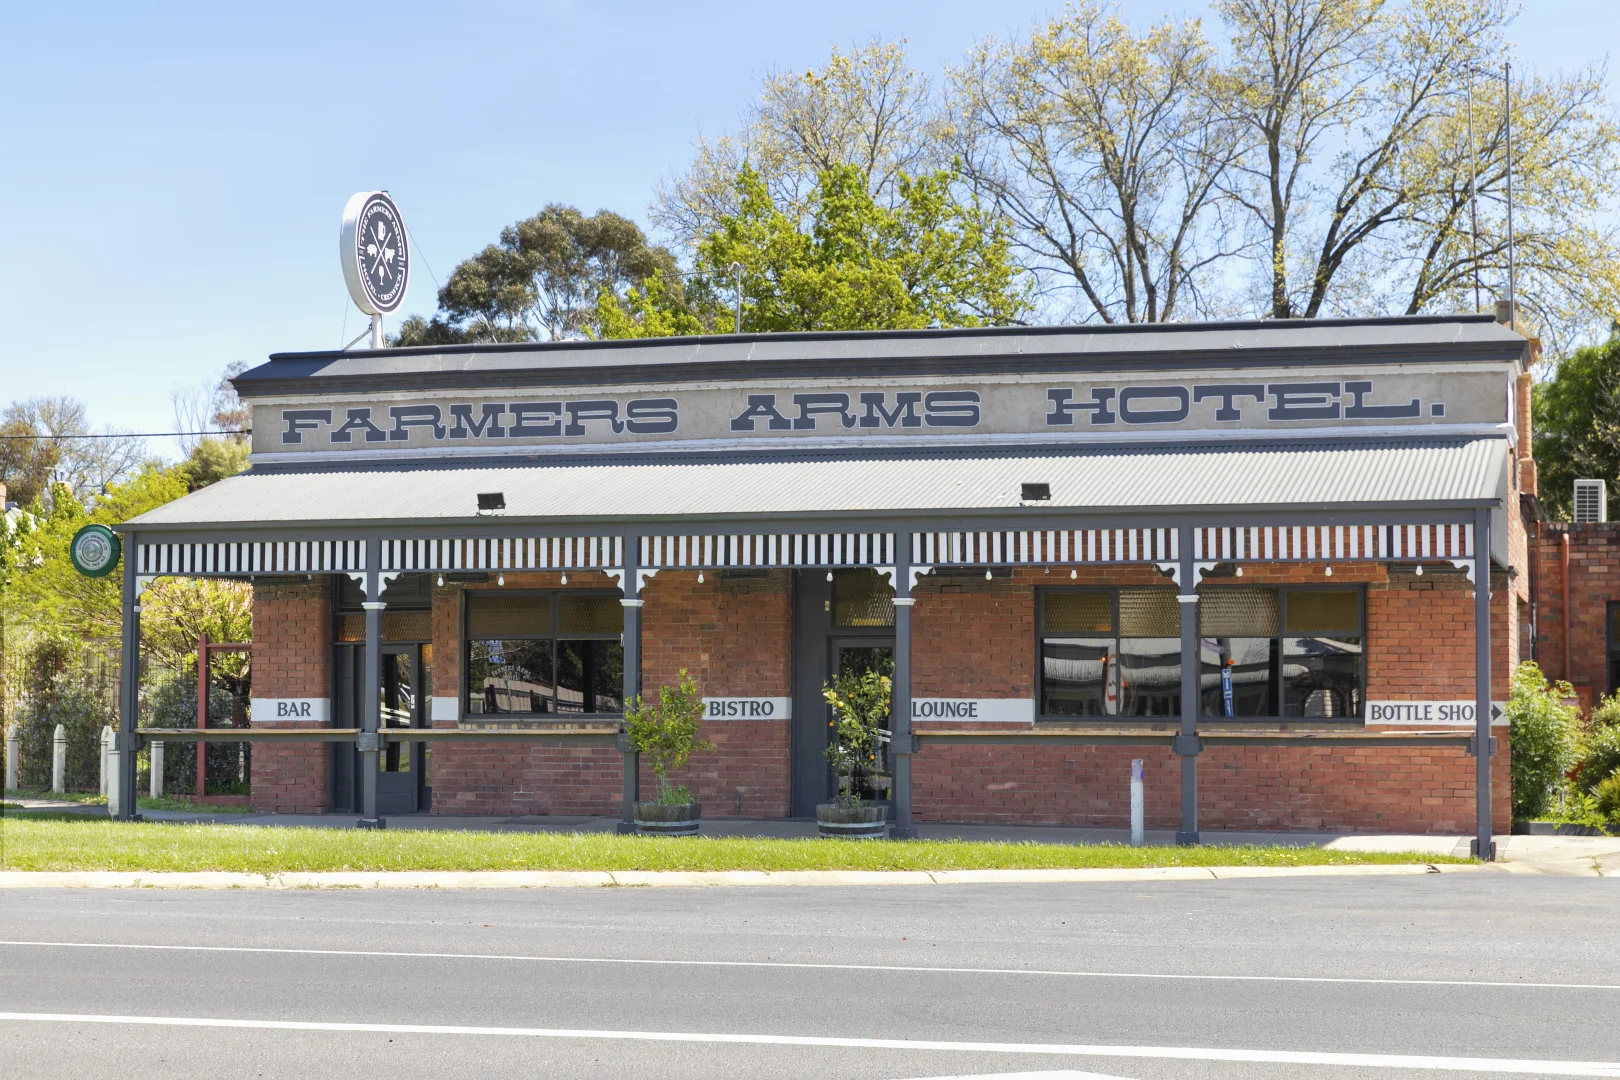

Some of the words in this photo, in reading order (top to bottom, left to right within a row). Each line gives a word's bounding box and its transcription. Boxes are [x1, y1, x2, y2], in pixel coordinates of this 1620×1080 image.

[367, 205, 392, 221] FARMERS
[391, 221, 403, 256] ARMS
[281, 397, 679, 446] FARMERS
[729, 389, 981, 432] ARMS
[277, 702, 311, 717] BAR
[709, 701, 774, 717] BISTRO
[912, 702, 978, 718] LOUNGE
[1371, 705, 1433, 720] BOTTLE
[1438, 705, 1477, 720] SHO
